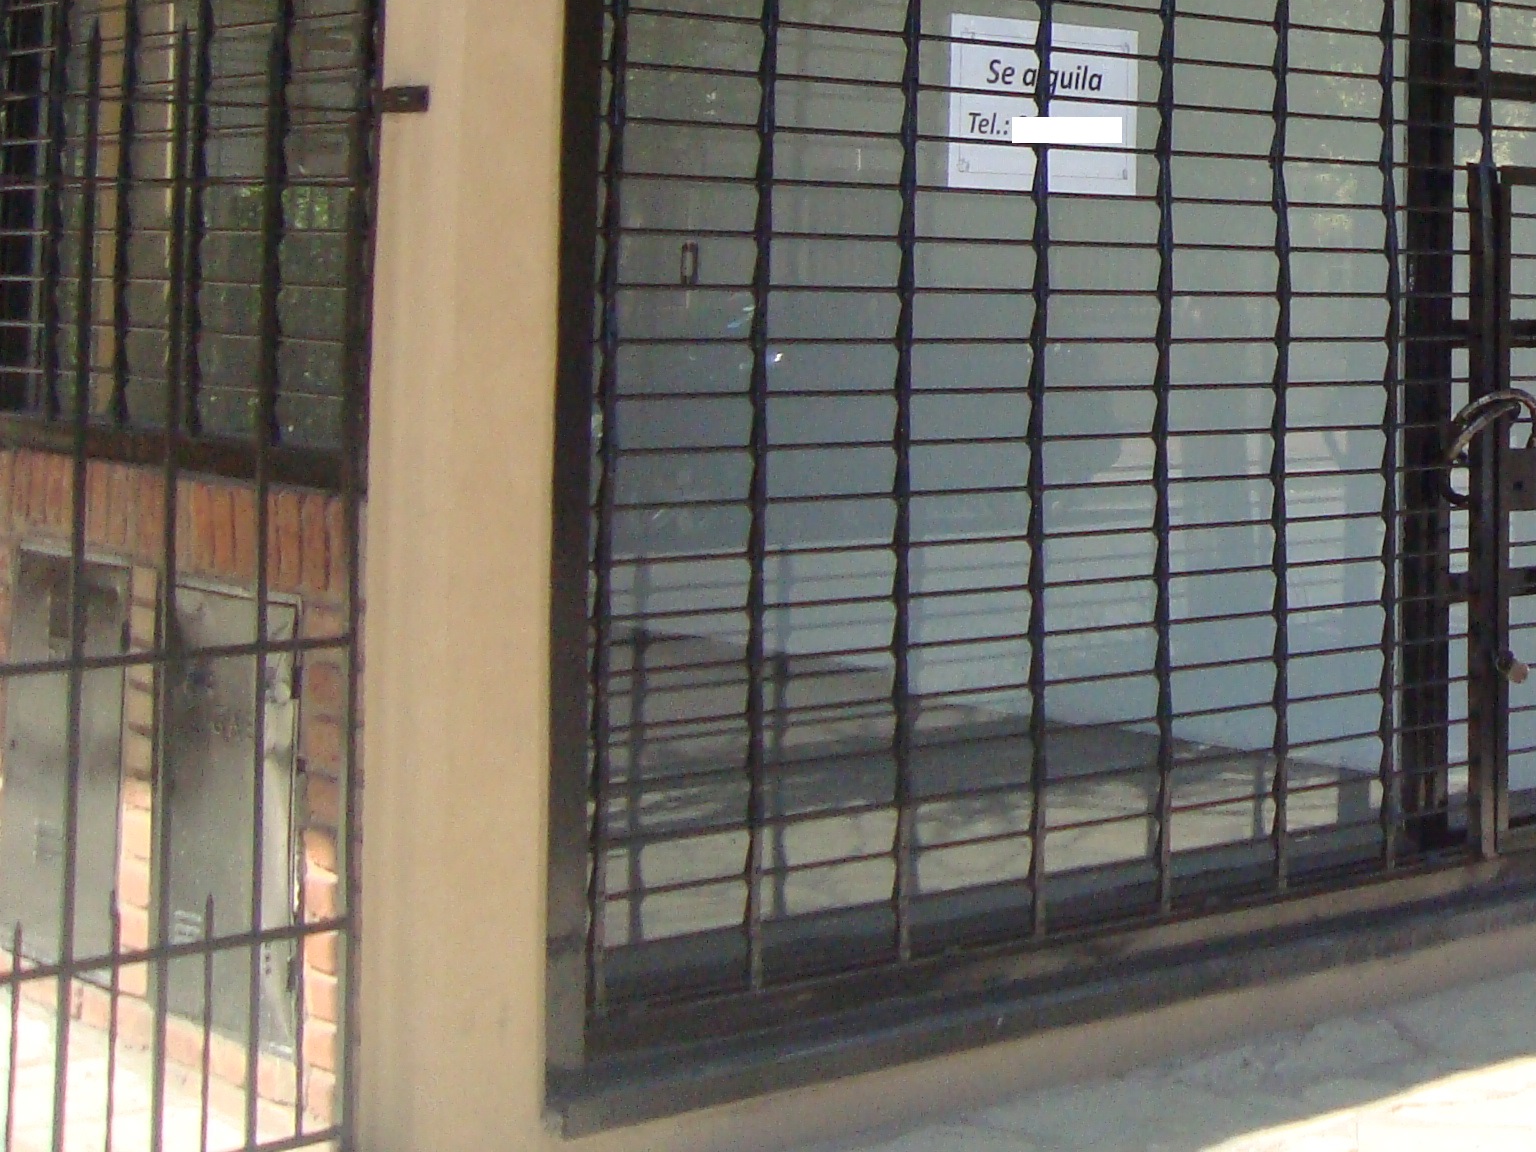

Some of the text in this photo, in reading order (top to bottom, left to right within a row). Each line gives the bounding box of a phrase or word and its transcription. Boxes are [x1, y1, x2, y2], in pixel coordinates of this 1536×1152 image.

[986, 59, 1103, 96] Se aquila
[968, 112, 1010, 136] Tel.:
